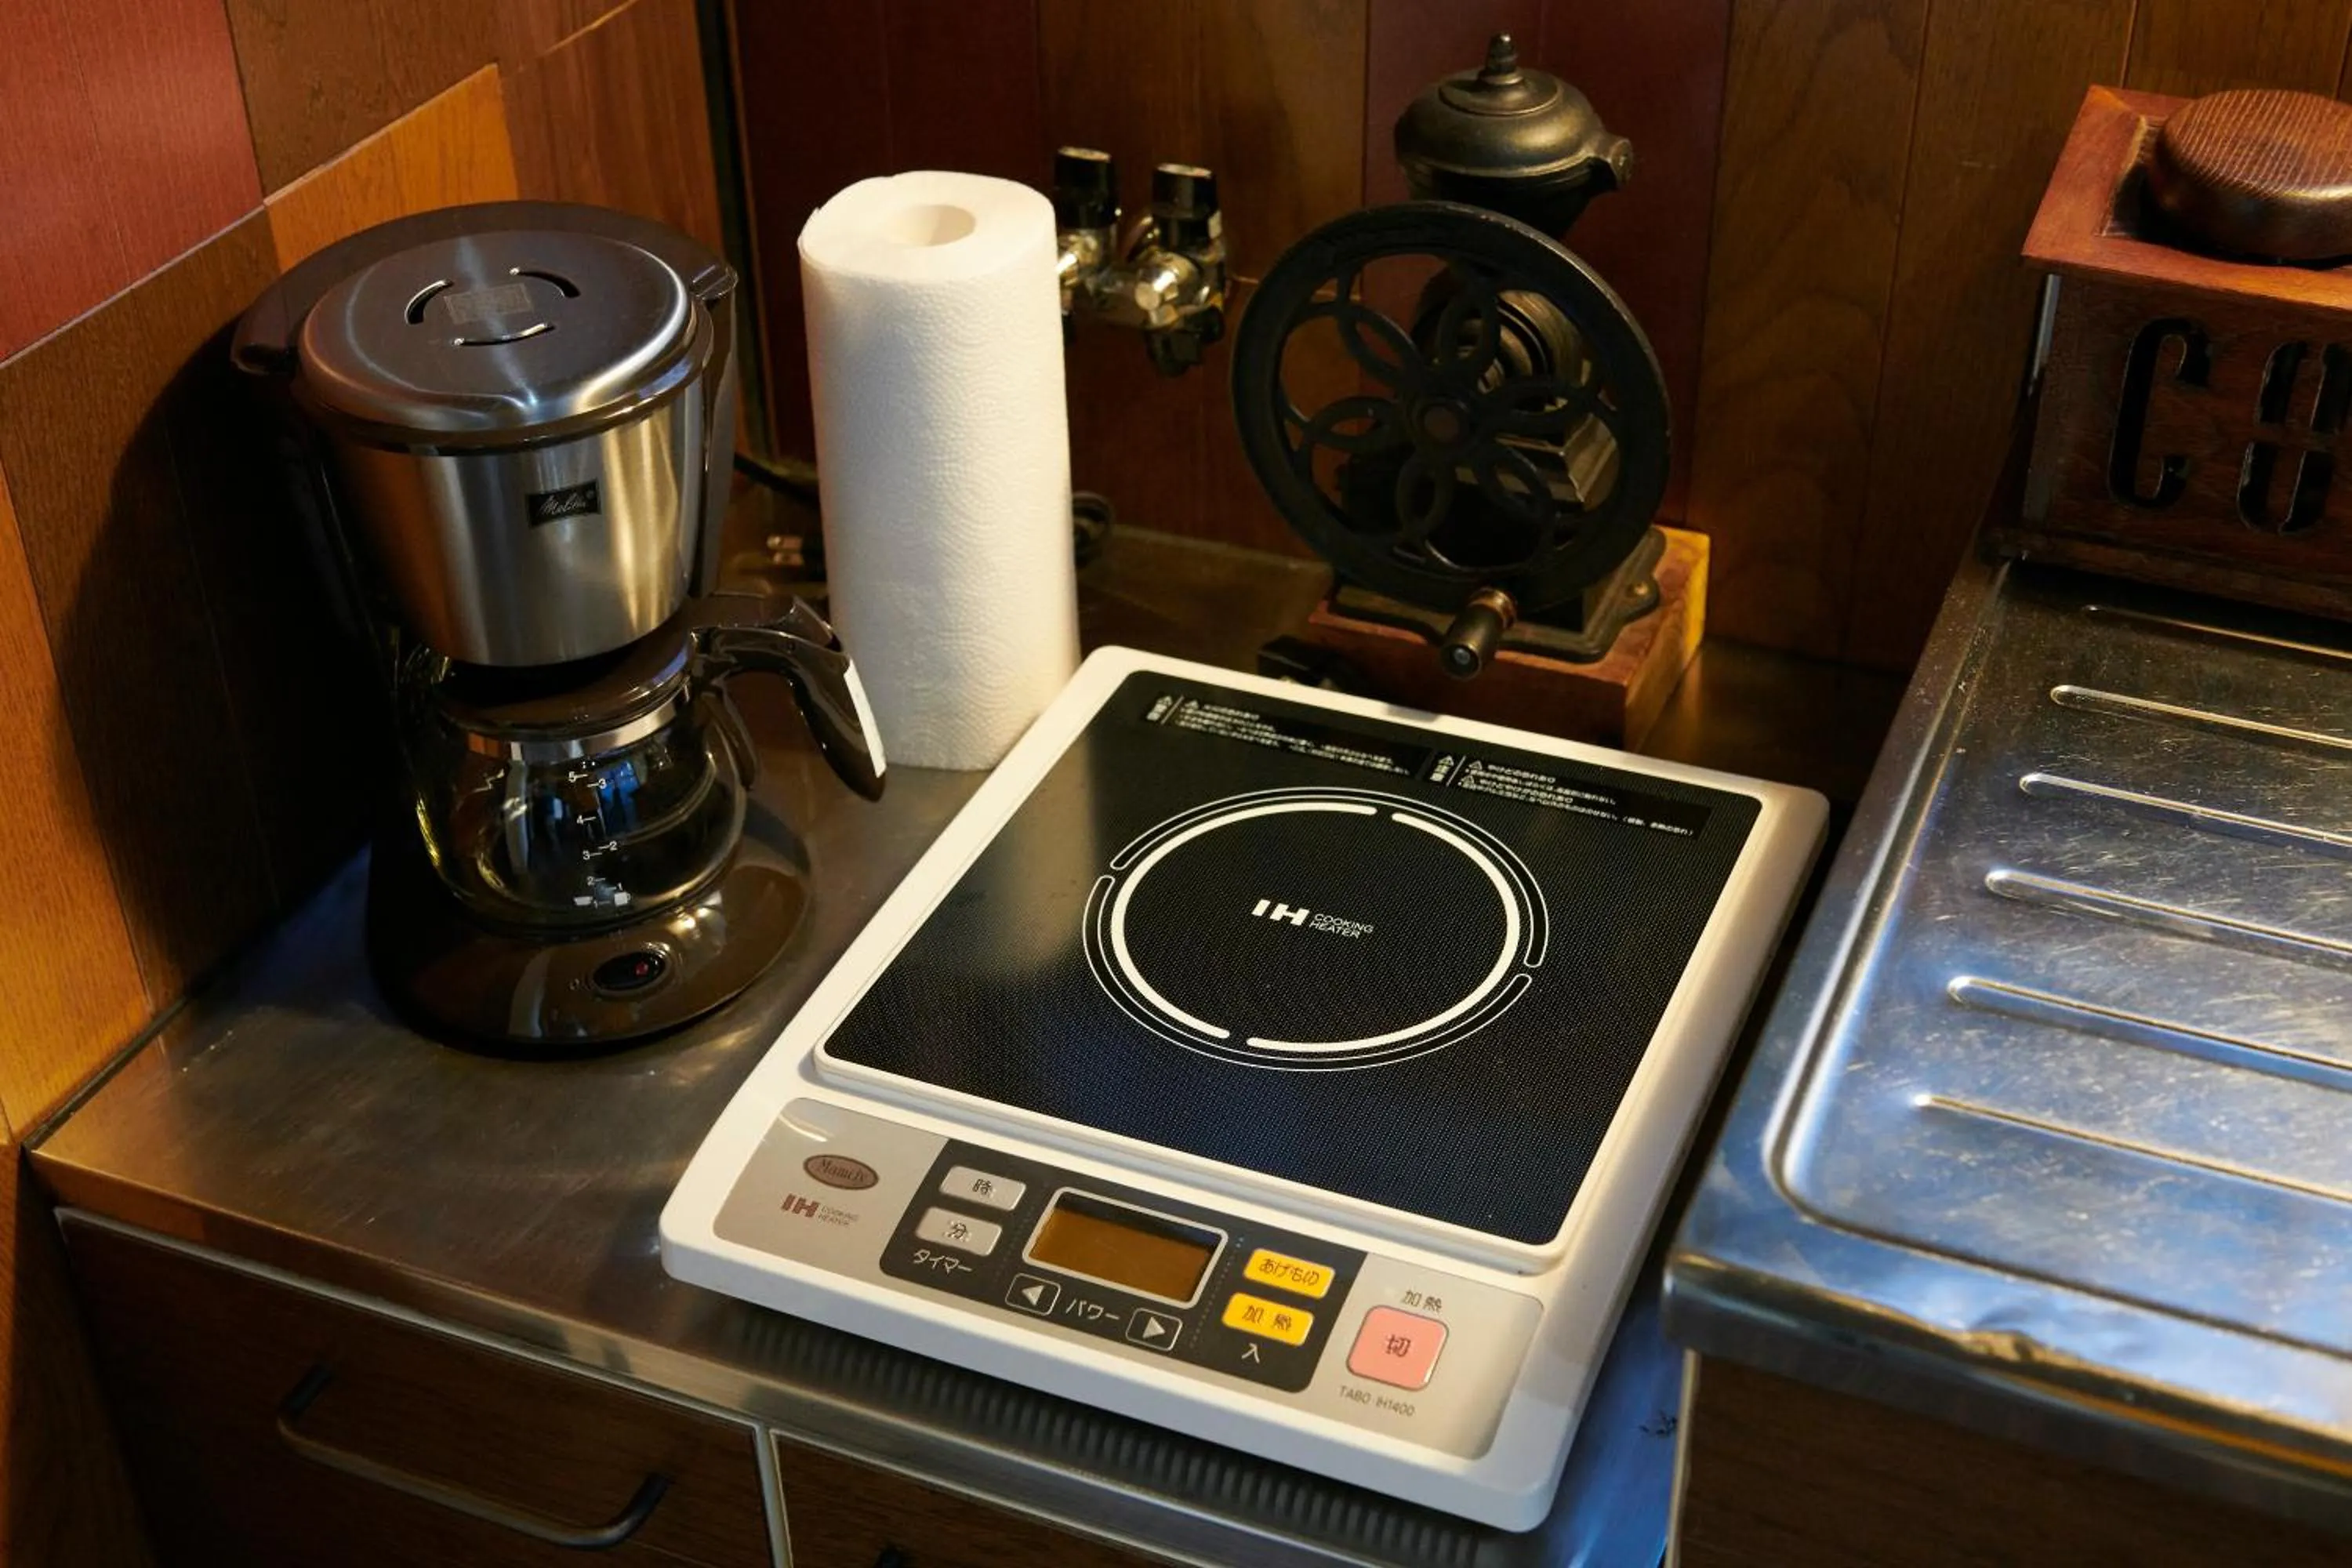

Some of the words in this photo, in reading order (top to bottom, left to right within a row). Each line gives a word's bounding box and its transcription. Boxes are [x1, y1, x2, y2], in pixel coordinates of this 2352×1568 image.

[1251, 899, 1310, 926] IH
[1314, 913, 1374, 934] COOKING
[1308, 920, 1361, 939] HEATER
[781, 1193, 820, 1218] IH
[946, 1222, 967, 1241] 分
[913, 1250, 974, 1276] タイマー
[1258, 1257, 1320, 1286] あげもの
[1065, 1298, 1121, 1321] パワー
[1241, 1342, 1260, 1364] 入
[1385, 1333, 1411, 1358] 切
[1339, 1385, 1371, 1405] TABO
